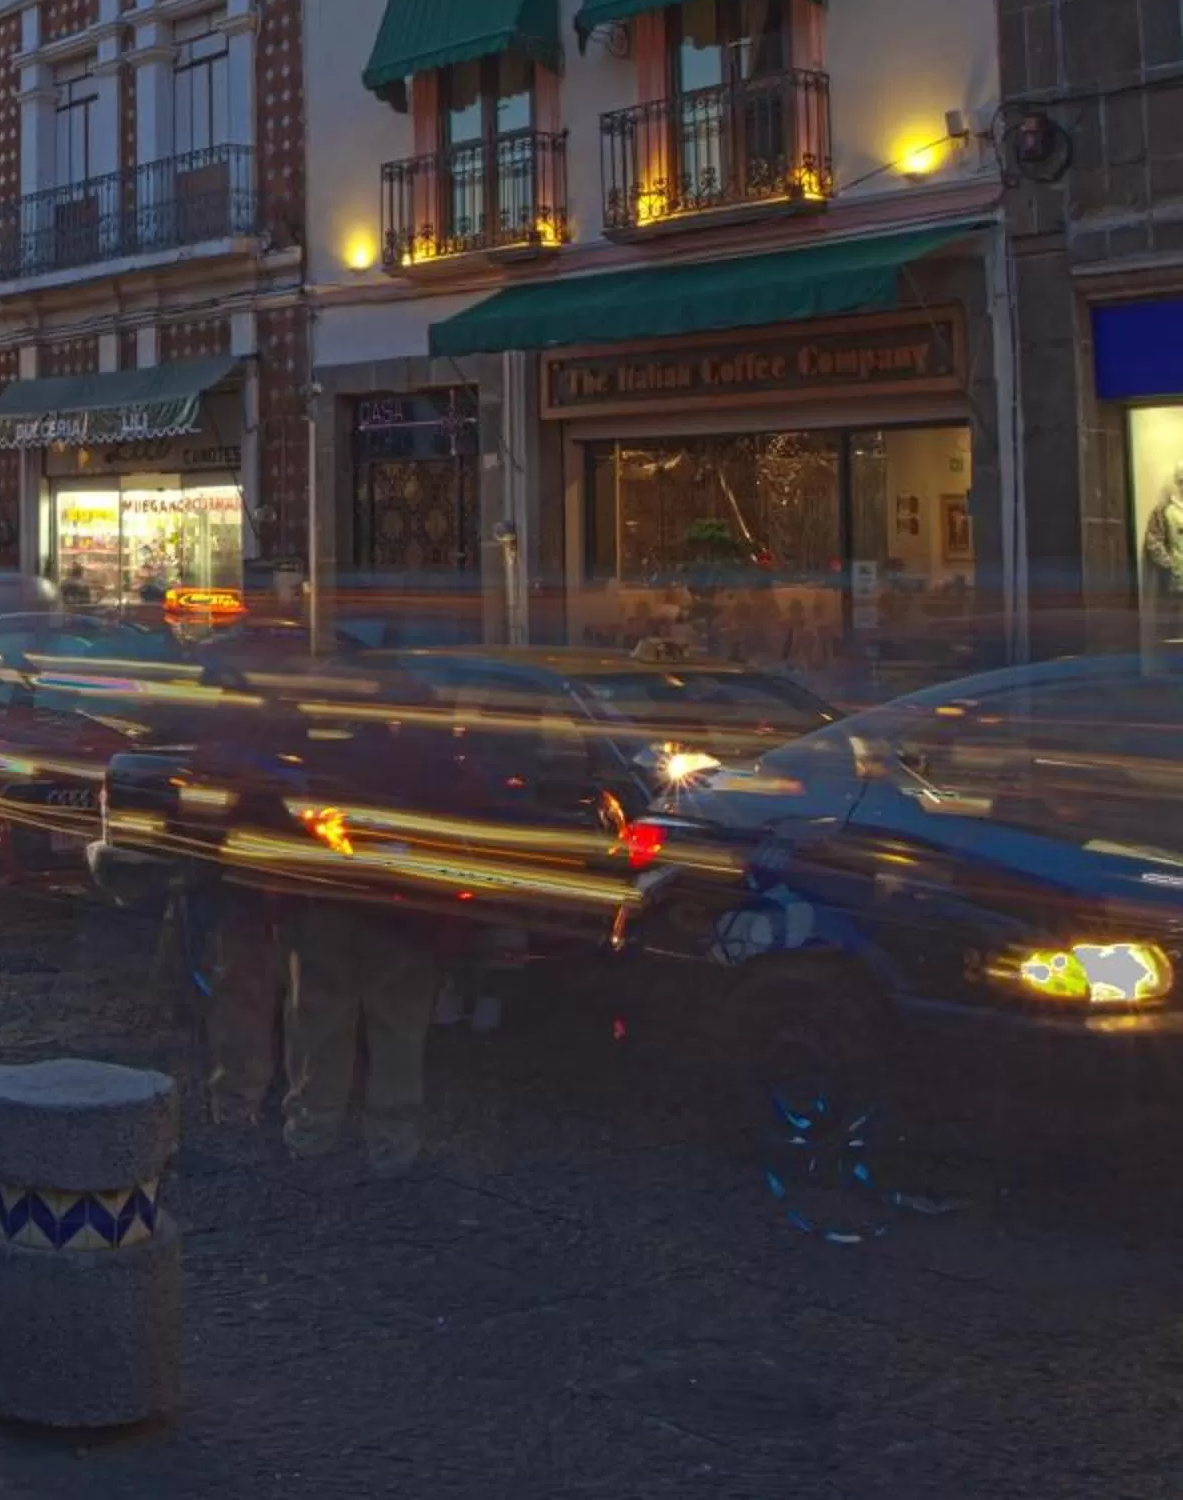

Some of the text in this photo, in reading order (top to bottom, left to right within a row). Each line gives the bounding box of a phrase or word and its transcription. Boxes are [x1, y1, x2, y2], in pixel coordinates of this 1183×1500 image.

[565, 342, 929, 396] The Italian Coffee Company
